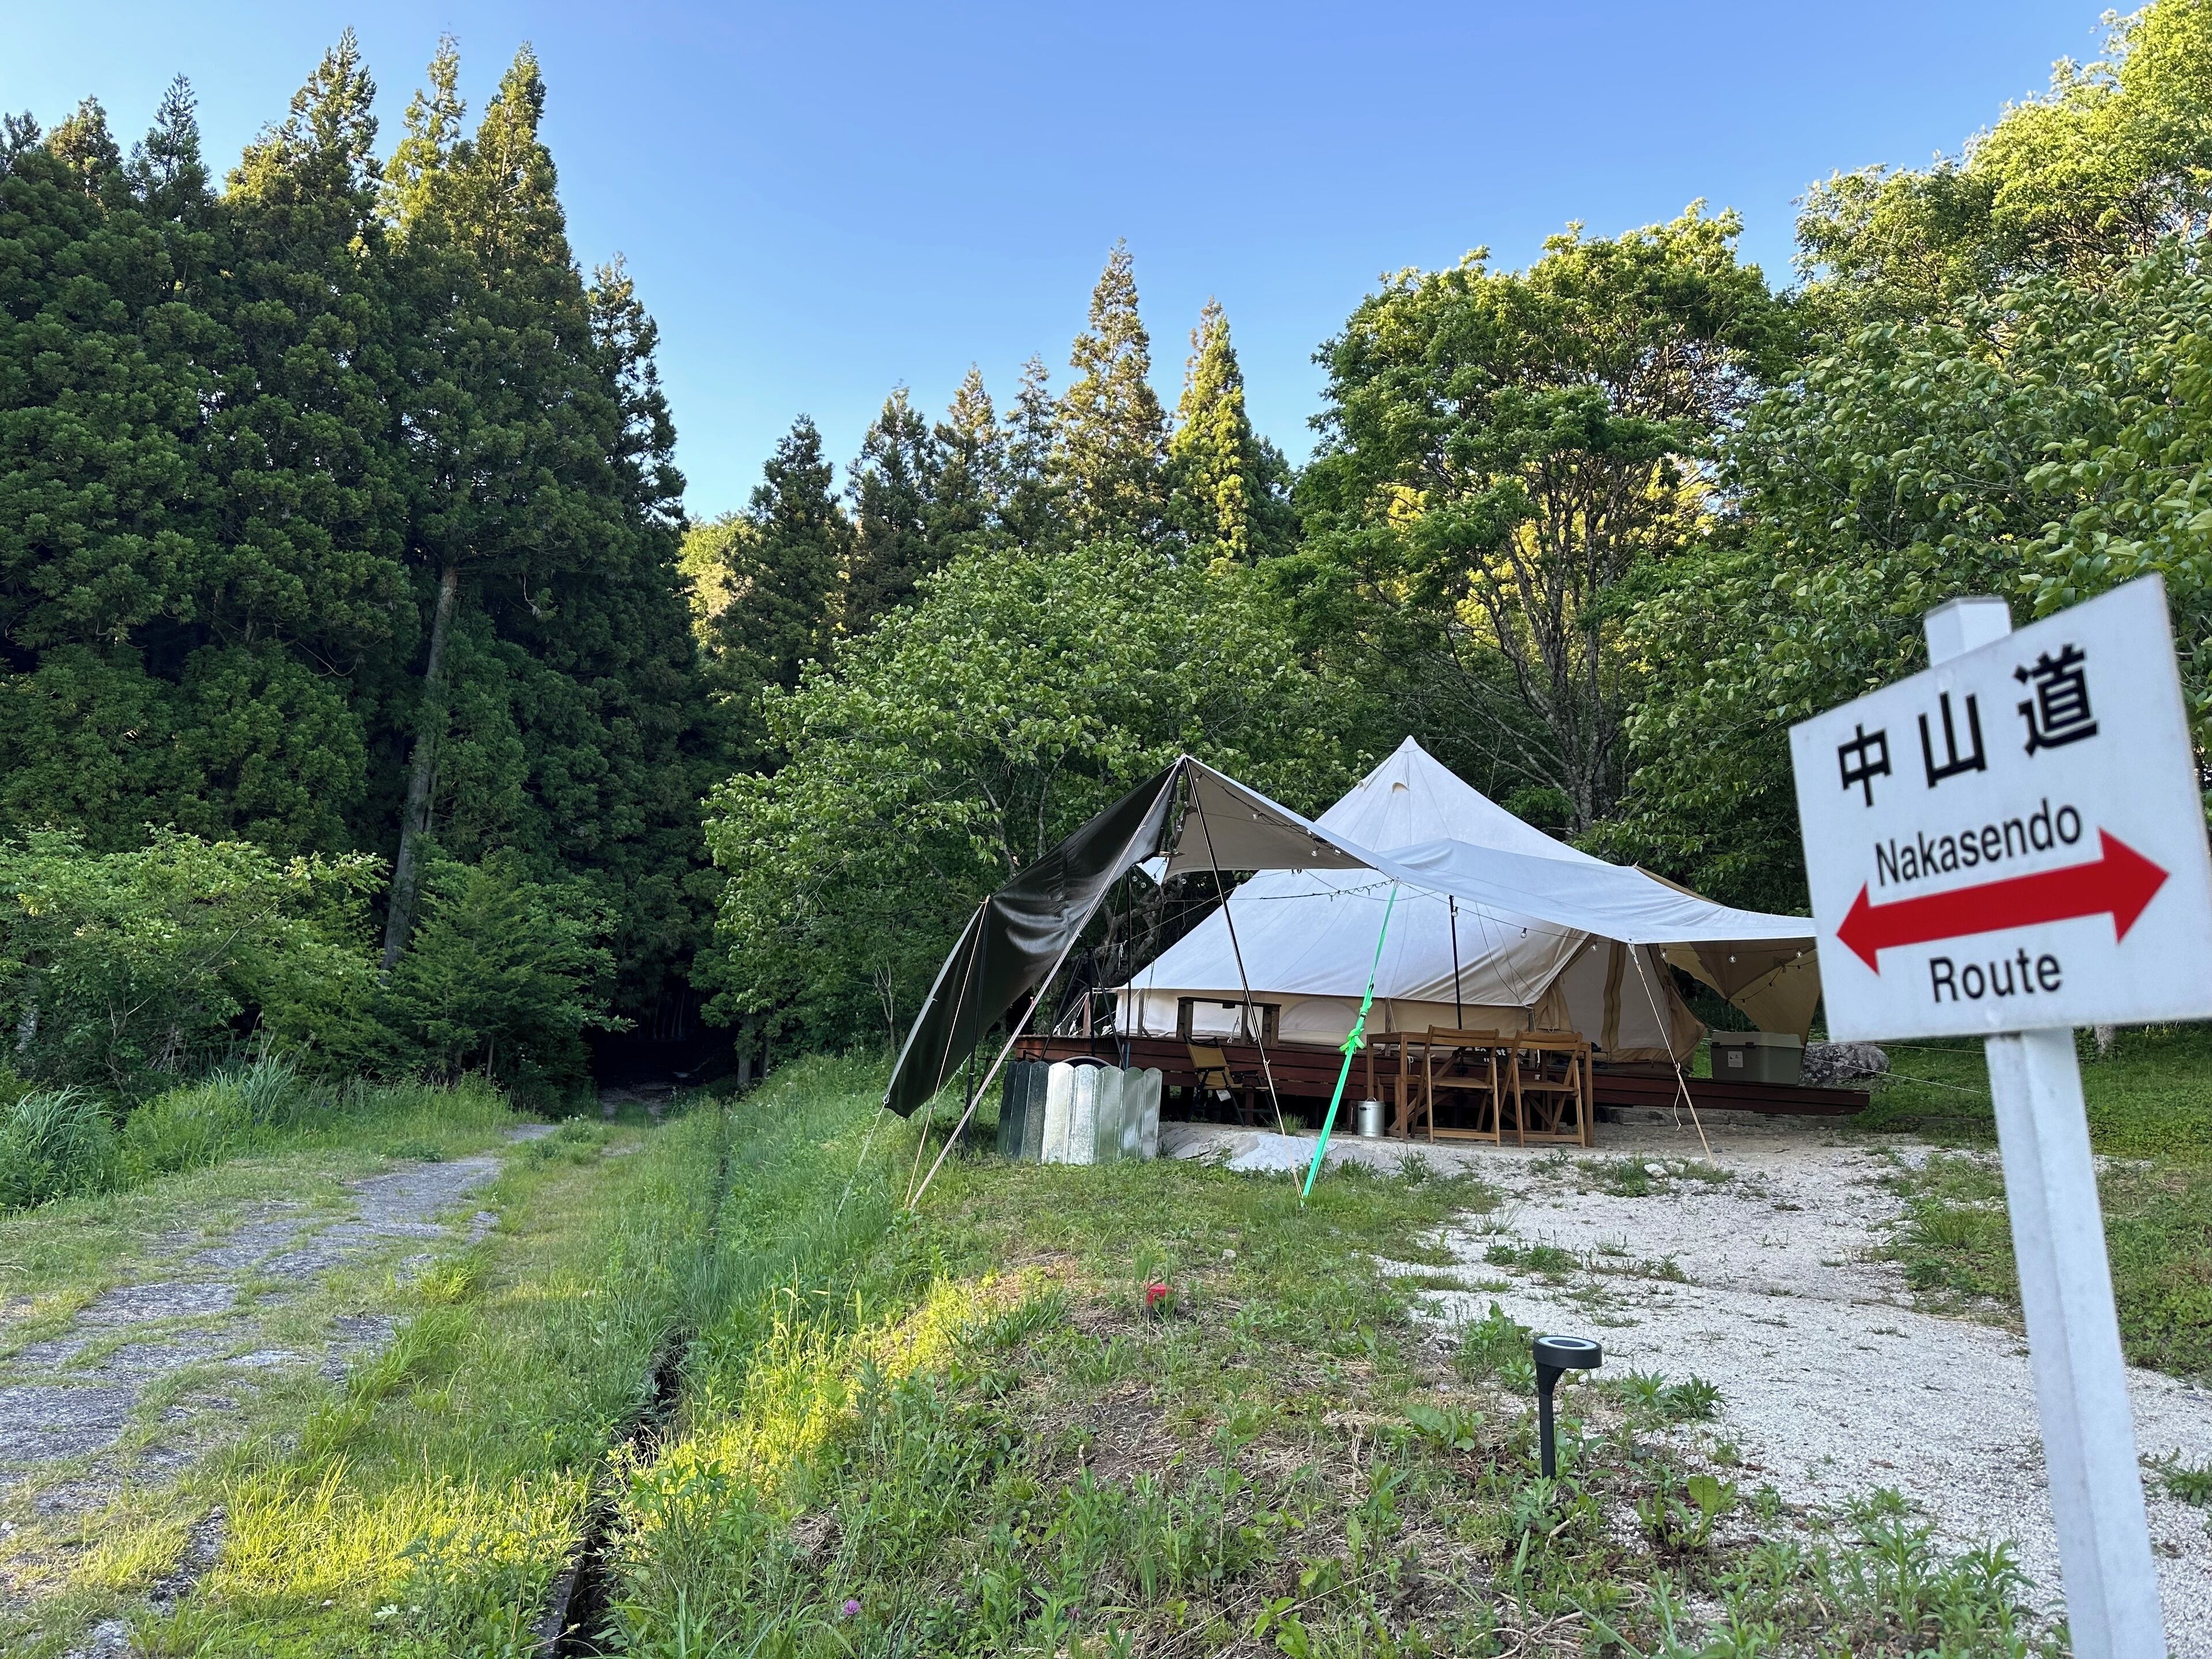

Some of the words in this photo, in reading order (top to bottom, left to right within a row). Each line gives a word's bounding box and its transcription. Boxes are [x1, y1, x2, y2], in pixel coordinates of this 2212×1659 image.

[1838, 644, 2099, 808] 中山道
[1876, 798, 2082, 887] Nakasendo
[1930, 949, 2061, 1003] Route
